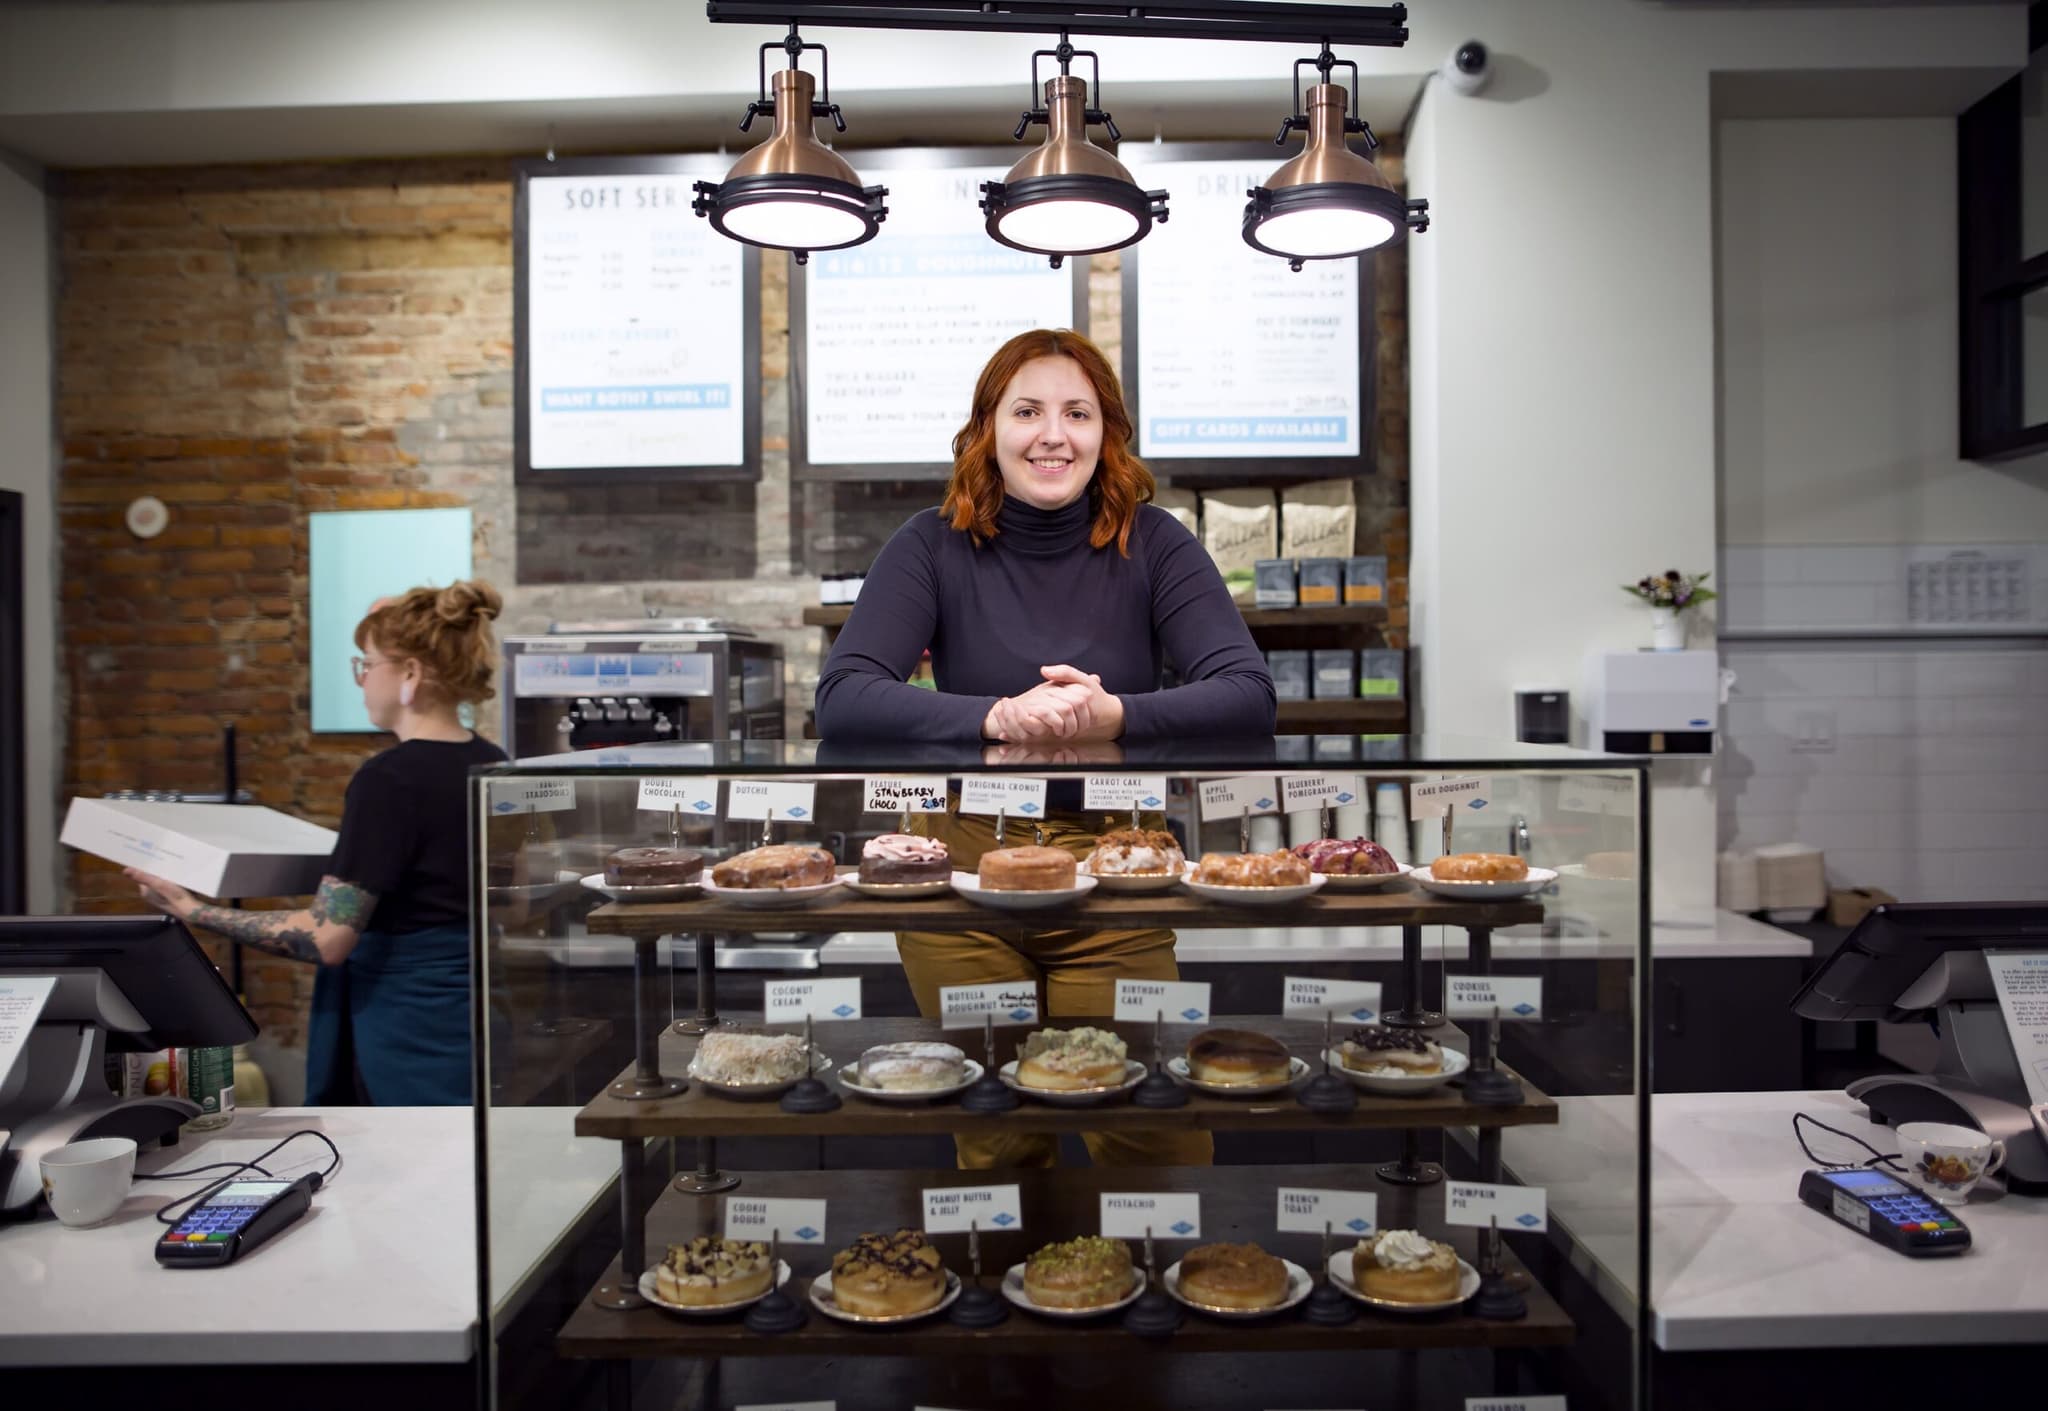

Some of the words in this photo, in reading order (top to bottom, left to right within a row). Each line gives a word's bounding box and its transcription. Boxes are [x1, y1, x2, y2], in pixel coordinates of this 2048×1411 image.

[565, 188, 621, 209] SOFT
[1156, 423, 1192, 438] GIFT
[1198, 422, 1249, 437] CARDS
[1255, 421, 1340, 437] AVAILABLE
[870, 780, 902, 788] FEATURE
[968, 781, 1005, 790] ORIGINAL
[1009, 783, 1040, 792] CRONUT
[1090, 778, 1119, 786] CARROT
[1122, 778, 1142, 787] CAKE
[1287, 778, 1325, 790] BLUEBERRY
[644, 788, 685, 798] CHOCOLATE
[736, 786, 768, 795] DUTCHIE
[1206, 784, 1227, 795] APPLE
[1288, 785, 1339, 799] POMEGRANATE
[1417, 787, 1435, 797] CAKE
[1439, 781, 1480, 793] DOUGHNUT
[1206, 792, 1235, 804] FRITTER
[869, 799, 897, 809] CHOCO
[772, 986, 813, 996] COCONUT
[1121, 985, 1165, 996] BIRTHDAY
[1291, 984, 1327, 995] BOSTON
[1453, 982, 1491, 992] COOKIES
[773, 998, 801, 1007] CREAM
[1121, 995, 1143, 1006] CAKE
[1290, 994, 1321, 1005] CREAM
[1467, 993, 1496, 1002] CREAM
[948, 1001, 997, 1013] DOUGHNUT
[930, 1194, 960, 1205] PEANUT
[963, 1192, 992, 1203] BUTTER
[1284, 1193, 1319, 1204] FRENCH
[1452, 1187, 1496, 1199] PUMPKIN
[733, 1203, 767, 1214] COOKIE
[1108, 1200, 1155, 1209] PISTACHIO
[1283, 1204, 1313, 1215] TOAST
[1452, 1199, 1467, 1209] PIE
[930, 1207, 936, 1216] &
[939, 1207, 960, 1216] JELLY
[732, 1215, 766, 1225] DOUGH
